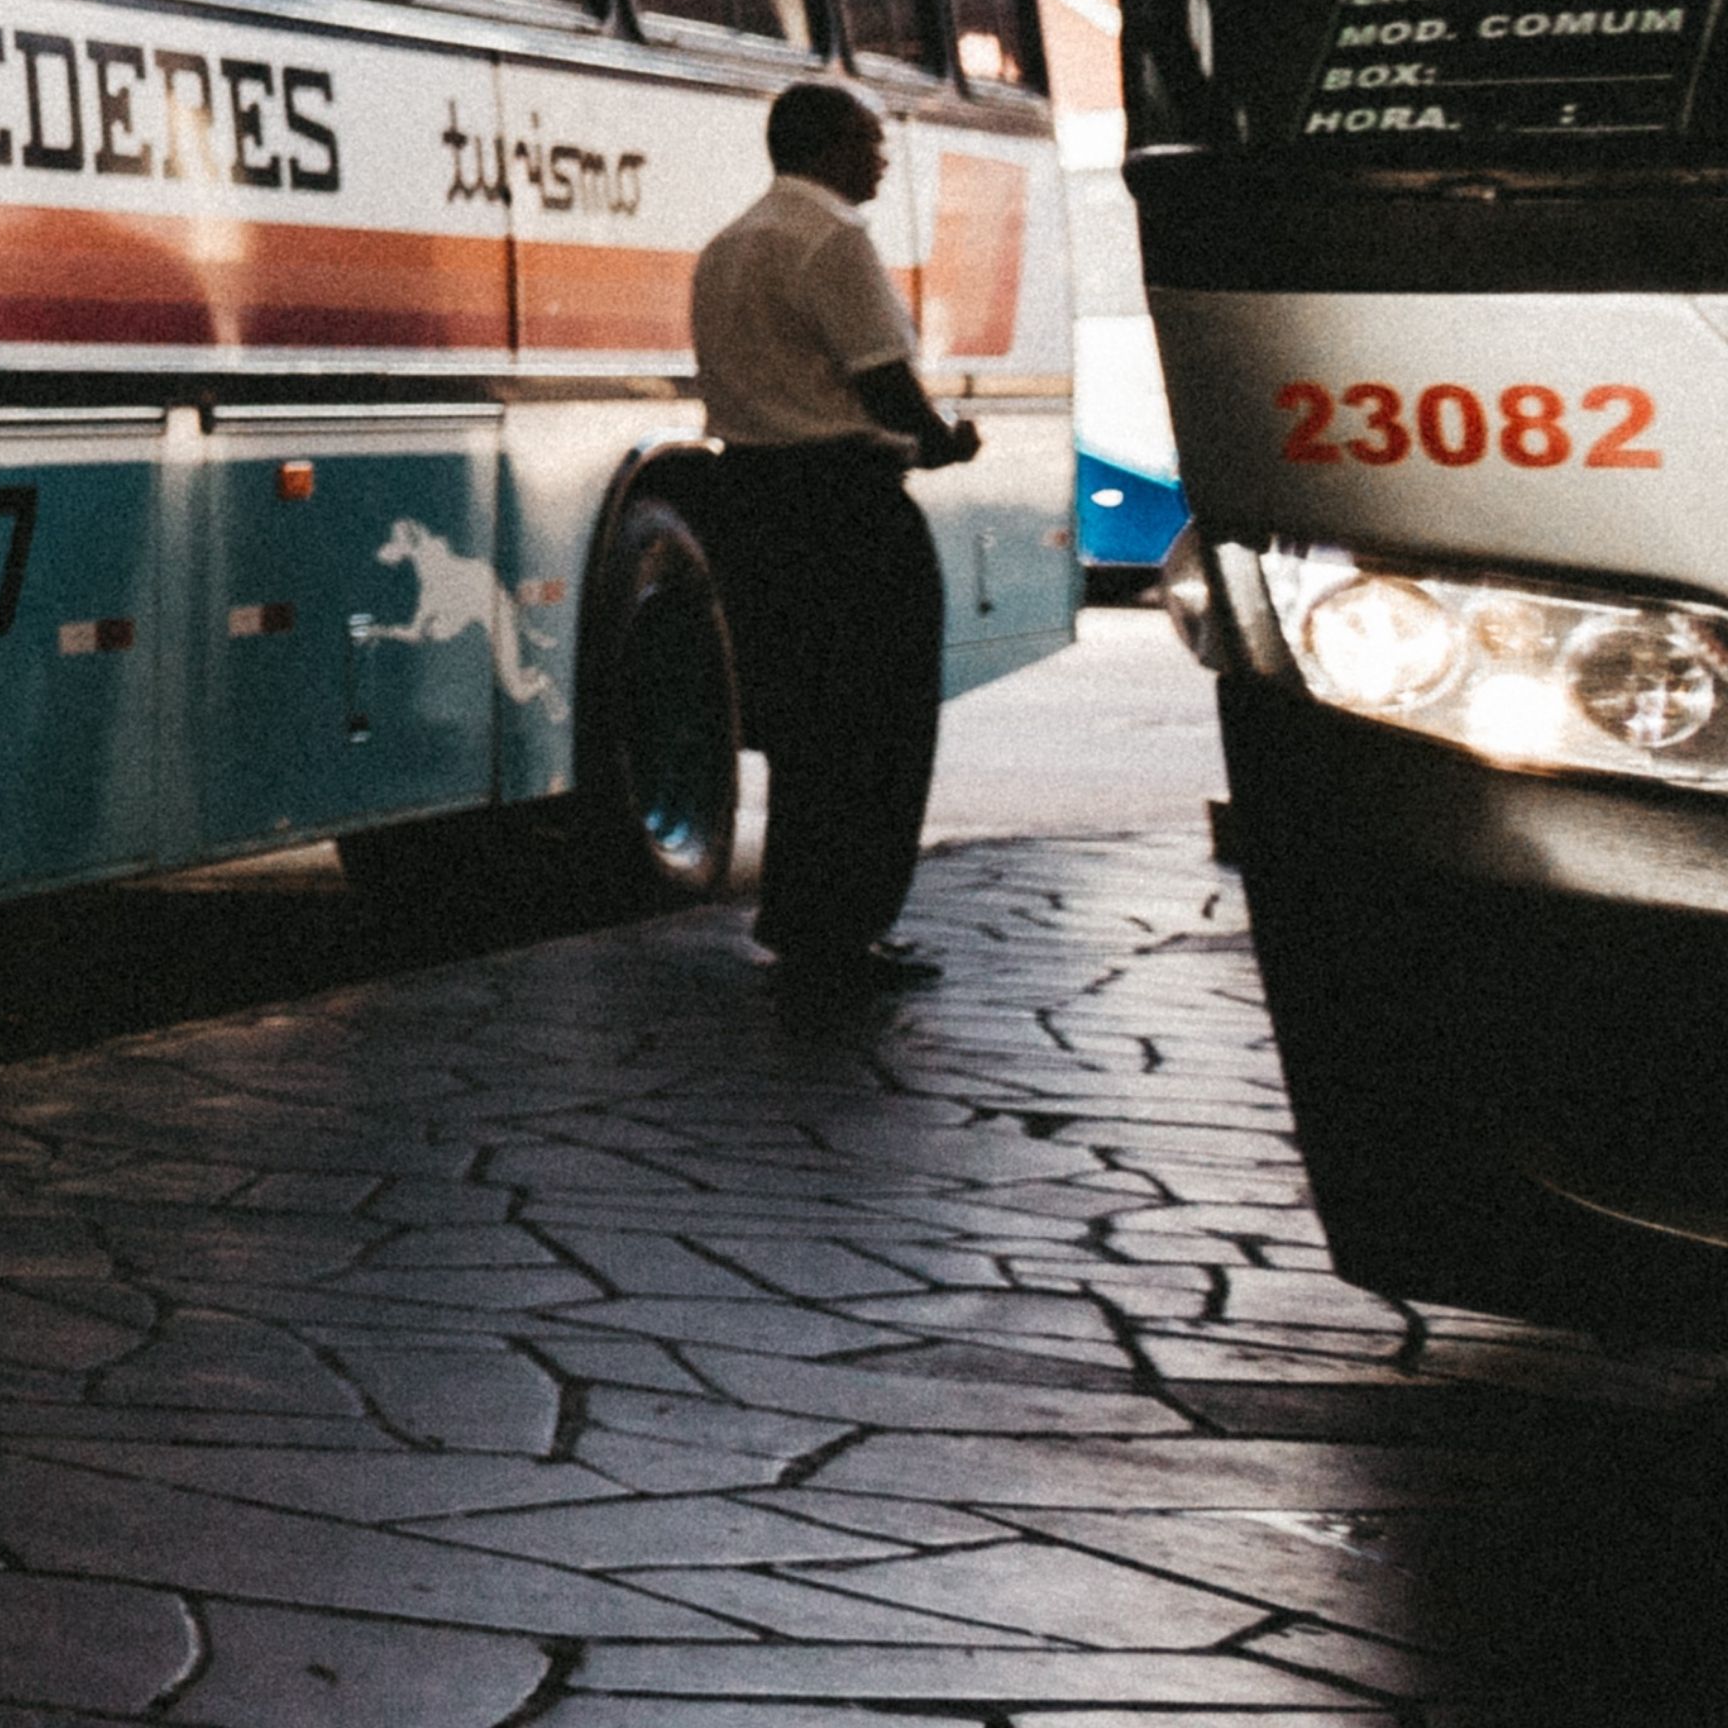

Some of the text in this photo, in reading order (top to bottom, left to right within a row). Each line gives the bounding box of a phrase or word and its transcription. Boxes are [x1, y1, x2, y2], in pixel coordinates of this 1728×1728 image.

[1337, 8, 1685, 48] MOD. COMUM
[1322, 62, 1436, 91] BOX:
[442, 97, 648, 217] turismo
[1274, 380, 1663, 469] 23082
